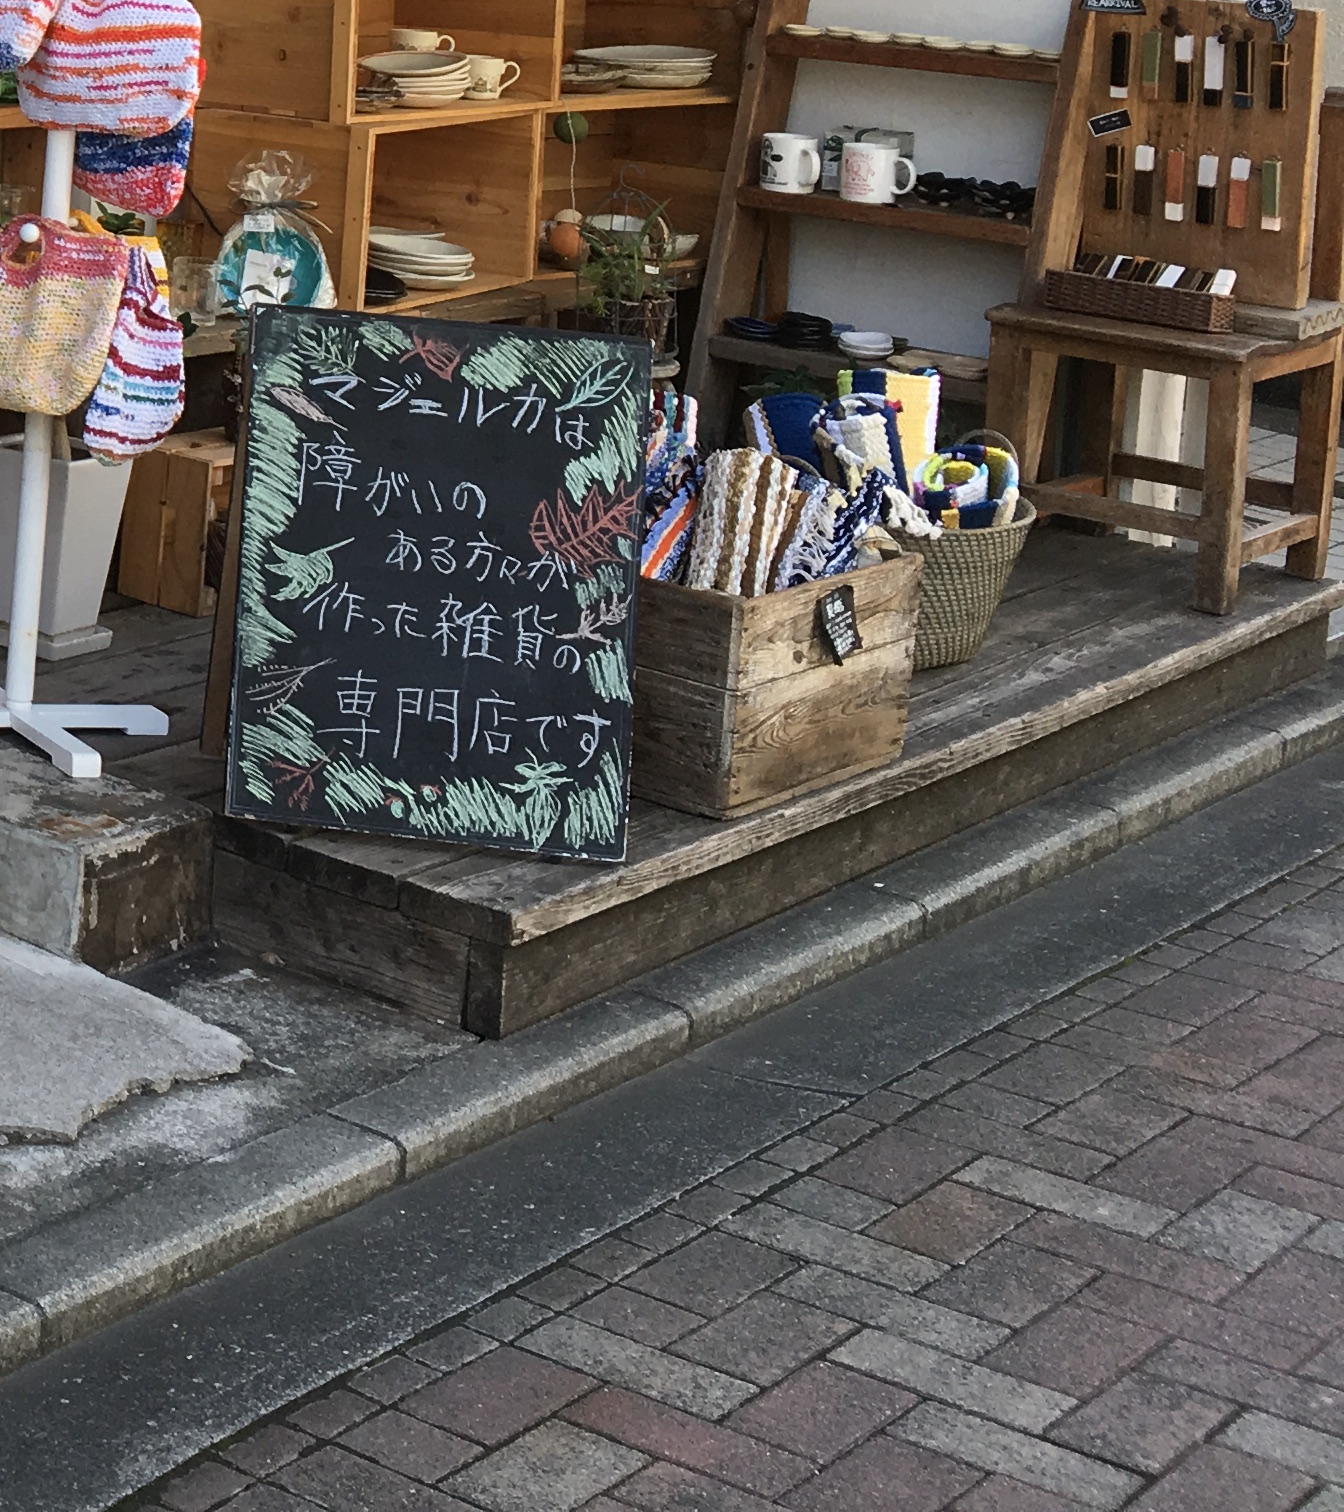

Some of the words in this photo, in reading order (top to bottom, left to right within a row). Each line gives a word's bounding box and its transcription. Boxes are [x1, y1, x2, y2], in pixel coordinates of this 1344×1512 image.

[308, 372, 595, 451] マジェルカは
[298, 430, 487, 520] 障がいの
[384, 528, 578, 592] ある方々が
[303, 580, 582, 674] 作った雑貨の
[316, 669, 612, 768] 専門店です
